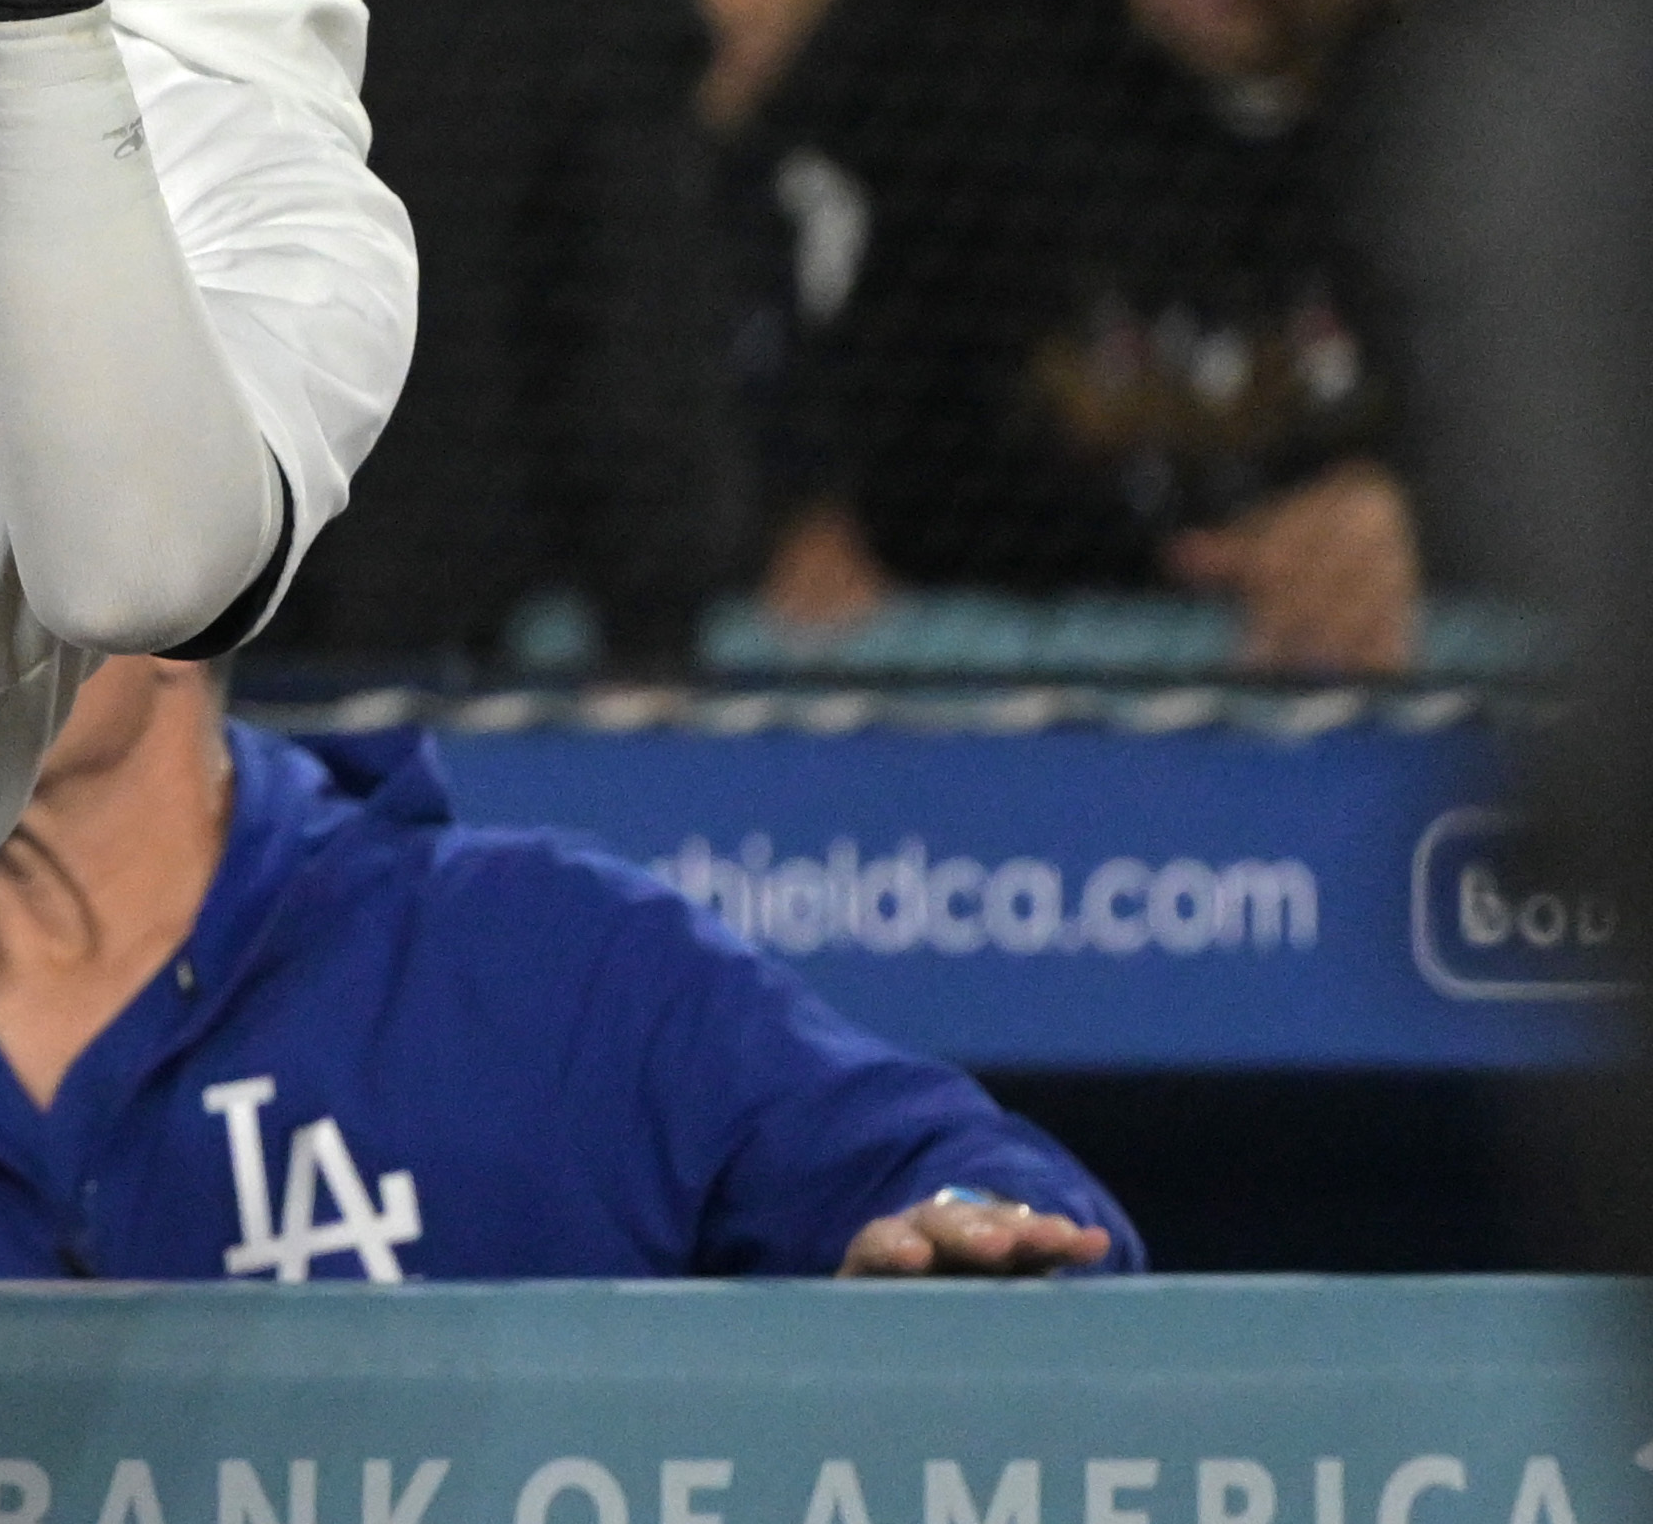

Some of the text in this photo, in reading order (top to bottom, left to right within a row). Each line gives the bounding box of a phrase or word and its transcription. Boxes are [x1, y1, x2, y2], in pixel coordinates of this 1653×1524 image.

[202, 1075, 425, 1283] LA
[514, 1458, 736, 1524] OF
[796, 1453, 1582, 1524] AMERICA
